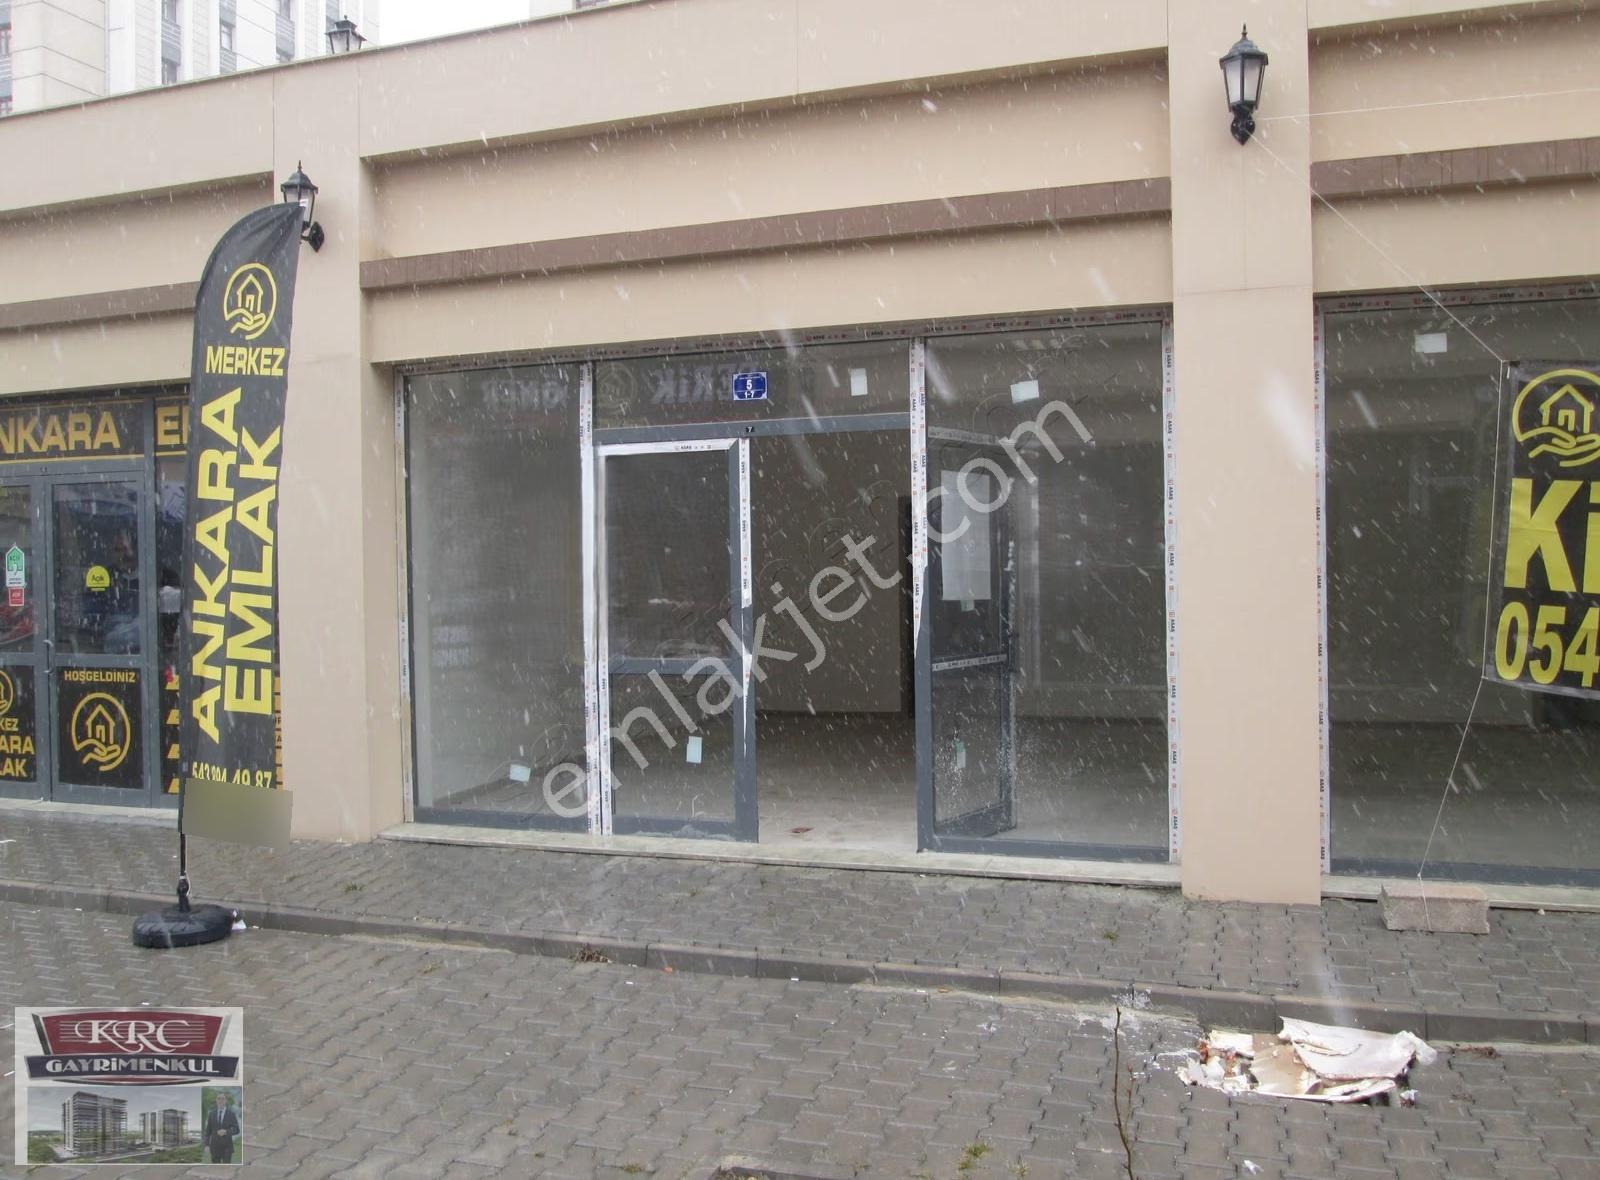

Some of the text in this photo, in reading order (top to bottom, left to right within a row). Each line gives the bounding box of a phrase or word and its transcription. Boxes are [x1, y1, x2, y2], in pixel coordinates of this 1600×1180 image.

[205, 345, 285, 376] MERKEZ
[746, 379, 753, 390] 5
[157, 406, 189, 446] E
[192, 387, 282, 744] ANKARA EMLAK
[1495, 602, 1600, 687] 054
